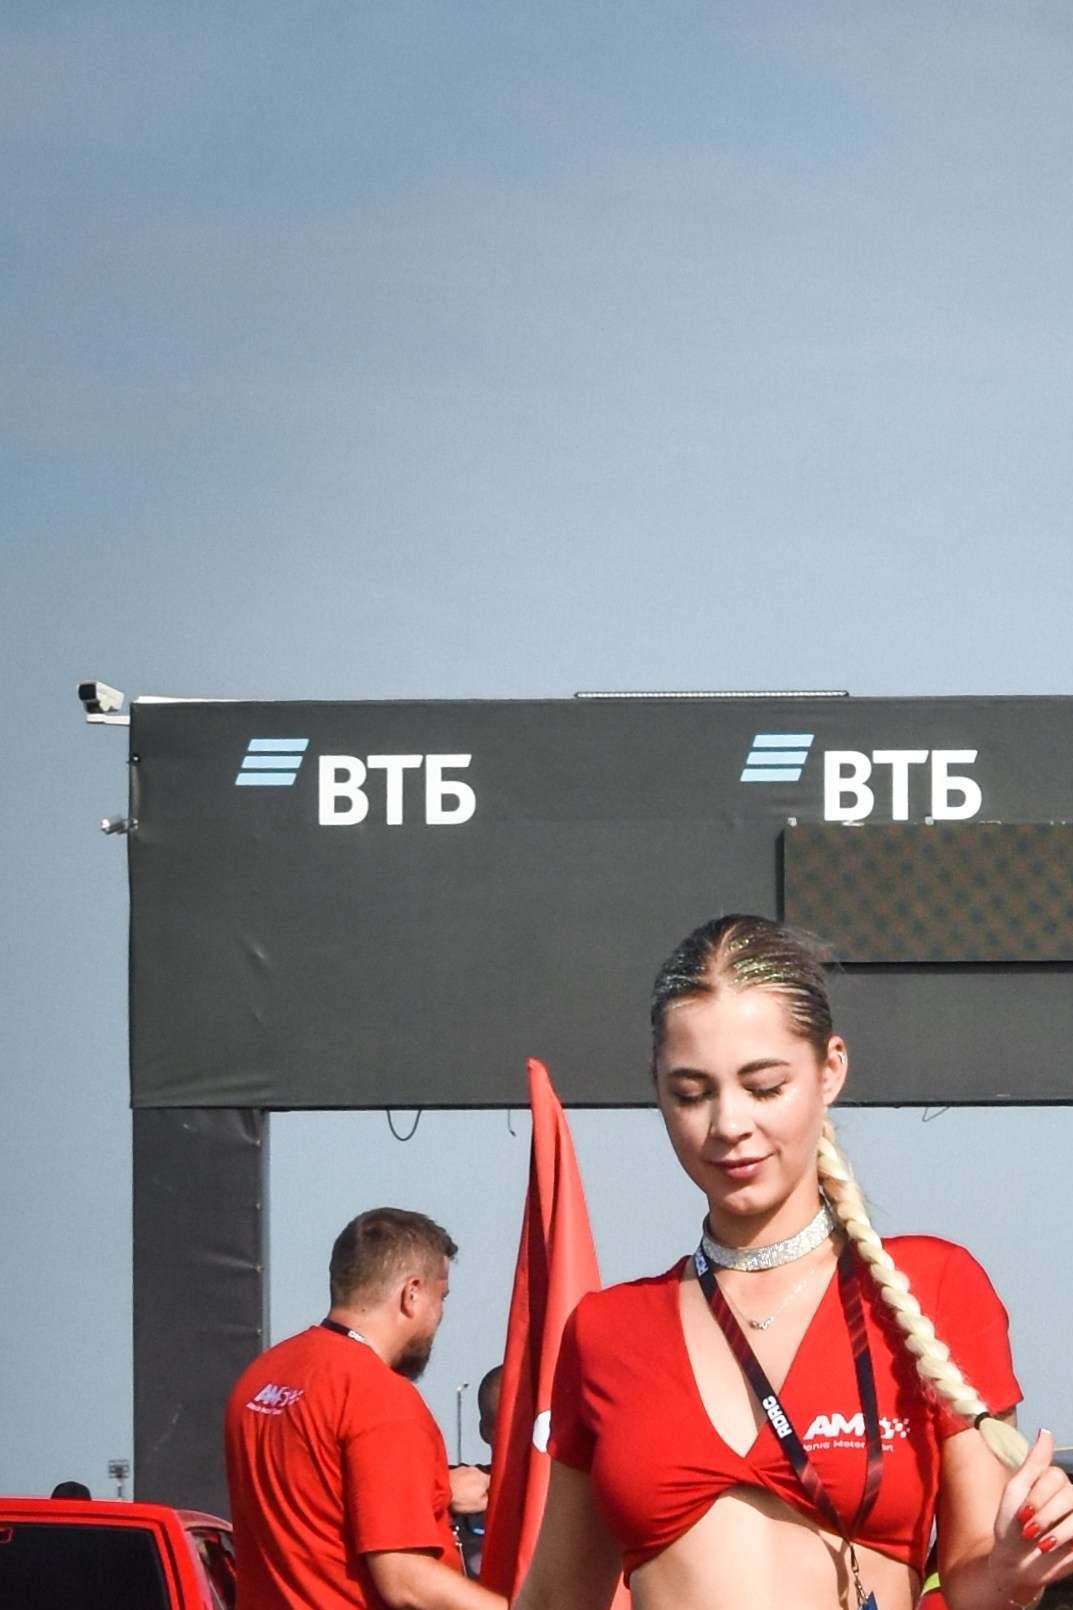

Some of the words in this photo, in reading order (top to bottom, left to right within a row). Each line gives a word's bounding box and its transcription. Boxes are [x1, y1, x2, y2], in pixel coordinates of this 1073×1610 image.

[318, 754, 477, 826] ВТБ
[822, 749, 983, 822] ВТБ
[762, 1395, 793, 1438] RDRC
